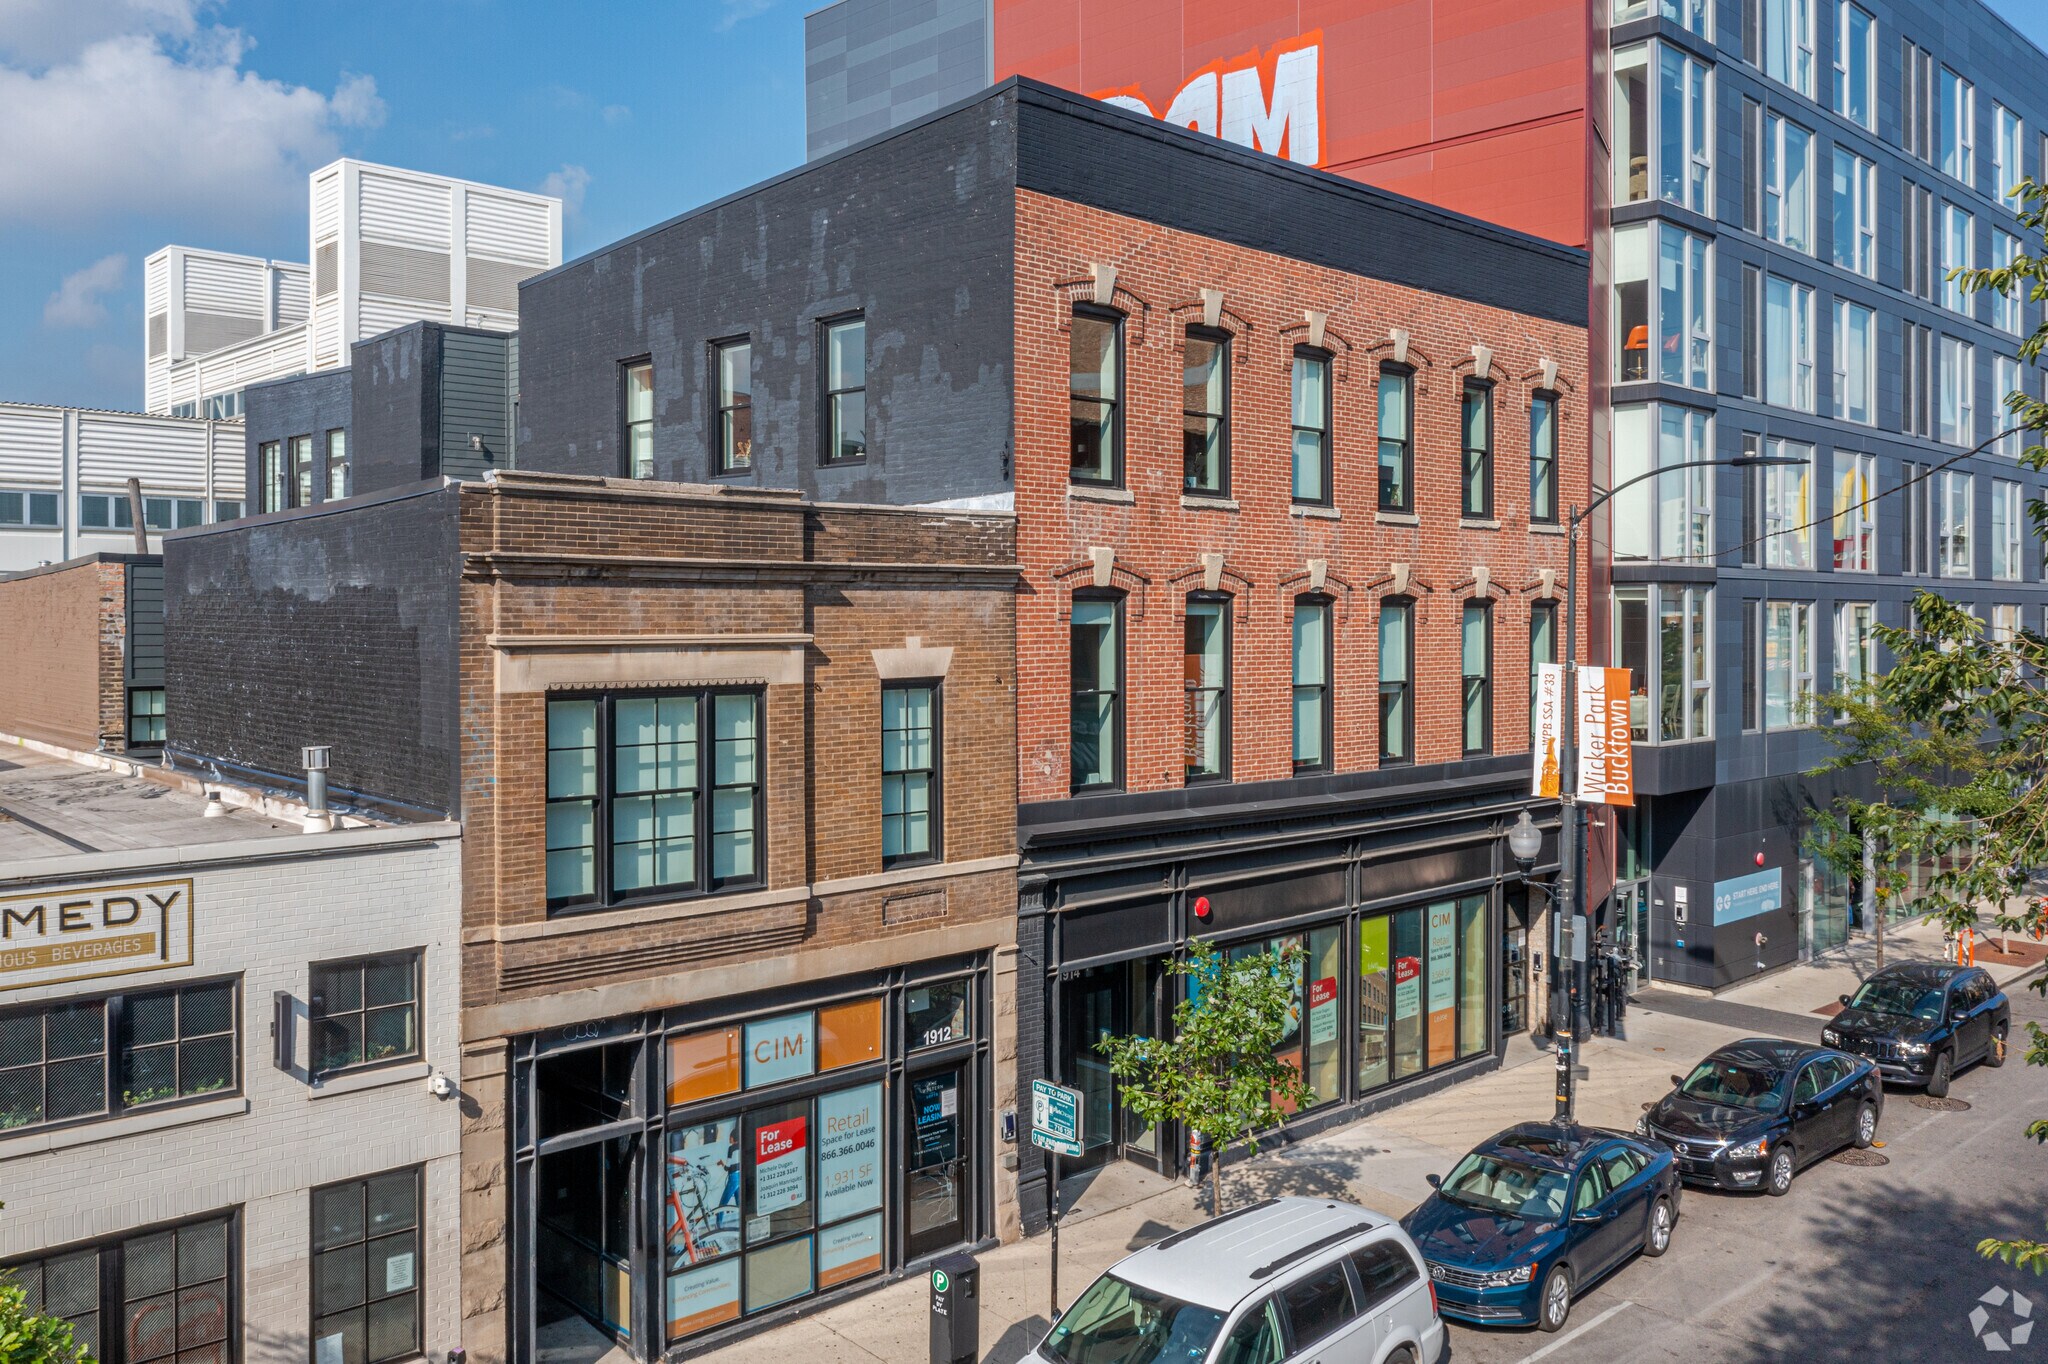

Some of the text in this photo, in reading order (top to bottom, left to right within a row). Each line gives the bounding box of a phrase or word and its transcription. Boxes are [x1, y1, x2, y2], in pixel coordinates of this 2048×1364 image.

[1543, 673, 1555, 697] #33
[1543, 701, 1553, 720] SSA
[1583, 685, 1605, 794] Wicker Park
[1604, 699, 1629, 795] Bucktown
[2, 891, 182, 963] MEDY
[1431, 912, 1451, 928] CIM
[52, 938, 142, 962] BEVERAGES
[1398, 961, 1408, 970] For
[1398, 969, 1414, 978] Lease
[1312, 984, 1323, 993] For
[1312, 991, 1330, 1003] Lease
[923, 1026, 951, 1045] 1912
[754, 1033, 803, 1064] CIM
[1036, 1083, 1047, 1093] PAY
[1048, 1088, 1056, 1097] TO
[1057, 1091, 1072, 1103] PARK
[923, 1103, 942, 1114] NOW
[828, 1107, 869, 1134] Retail
[917, 1112, 943, 1125] LEASIN
[760, 1129, 779, 1143] For
[821, 1126, 876, 1147] Space for Lease
[761, 1139, 793, 1155] Lease
[821, 1139, 875, 1161] 866.366.0046
[825, 1163, 873, 1189] 1,931 SF
[824, 1178, 874, 1198] Available Now
[684, 1281, 705, 1292] Creating
[935, 1294, 944, 1302] PAY
[932, 1305, 947, 1315] PLATE
